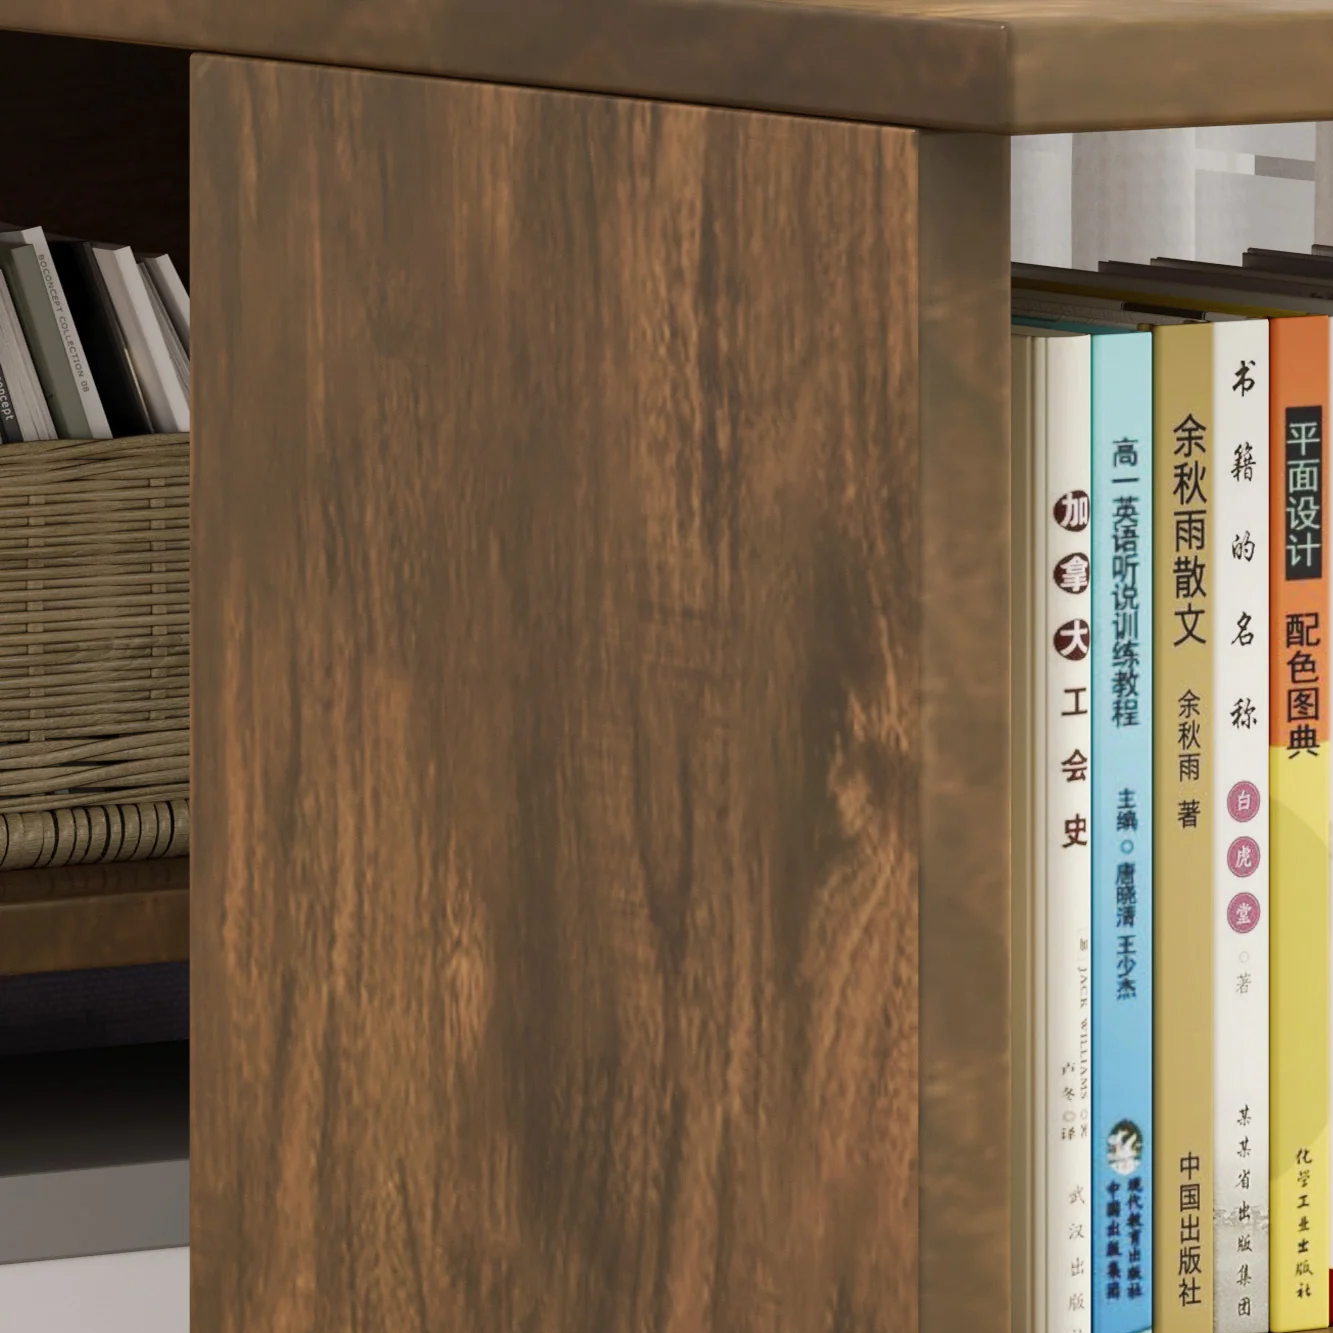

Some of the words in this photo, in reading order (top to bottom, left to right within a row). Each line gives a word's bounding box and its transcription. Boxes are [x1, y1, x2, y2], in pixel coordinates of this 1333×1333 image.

[37, 254, 64, 312] BOCONCEPT
[59, 315, 84, 377] COLLECTION
[1172, 412, 1208, 647] 余秋雨散文
[1230, 358, 1257, 731] 书籍的名称
[1284, 419, 1322, 568] 平面设计
[1111, 436, 1140, 729] 高一英语听说训练教程
[1059, 491, 1089, 849] 加拿大工会史
[1177, 690, 1201, 782] 余秋雨
[1285, 612, 1321, 760] 配色图典
[1177, 799, 1201, 829] 著
[1177, 1151, 1202, 1308] 中国出版社
[1235, 1103, 1253, 1318] 某某省出版集团
[1294, 1147, 1314, 1300] 化学工业出版社
